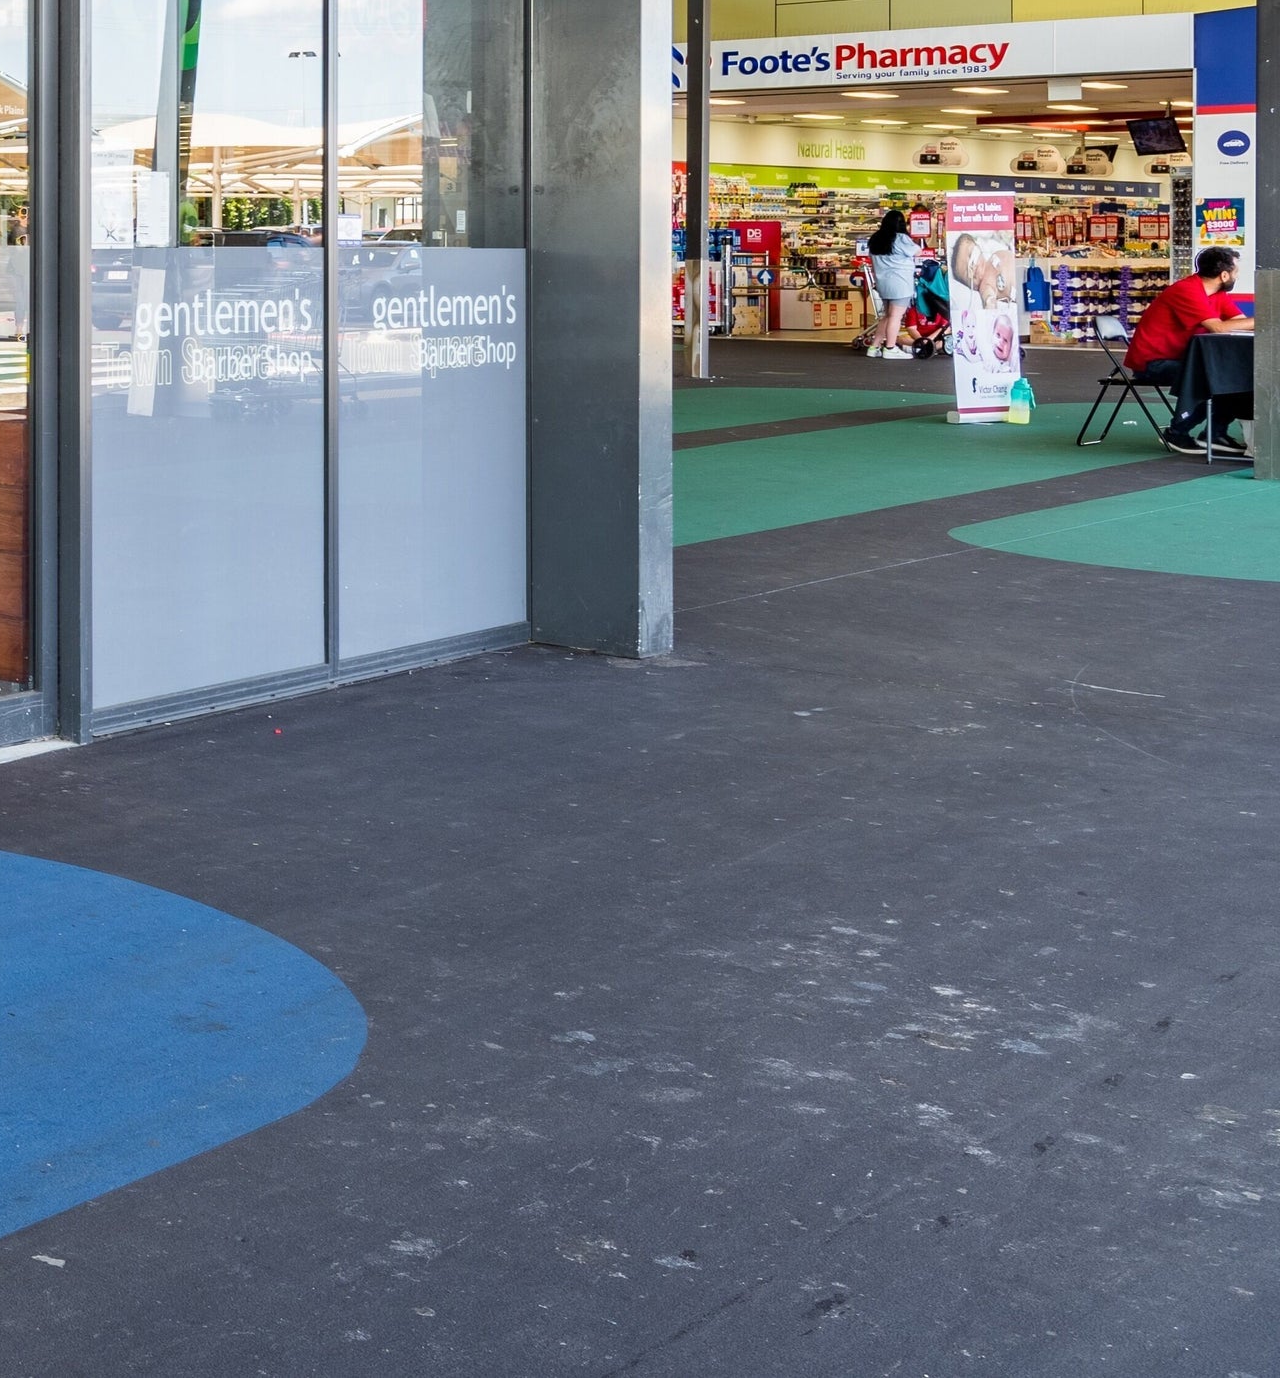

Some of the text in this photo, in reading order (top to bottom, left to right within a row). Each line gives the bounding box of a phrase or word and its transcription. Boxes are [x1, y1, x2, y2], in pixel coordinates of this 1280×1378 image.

[722, 42, 1010, 76] Foote's Pharmacy
[836, 72, 872, 80] Serving
[875, 71, 896, 79] your
[900, 69, 930, 78] family
[962, 65, 988, 73] 1983
[4, 105, 25, 116] Plains
[797, 139, 866, 161] Natural Health
[985, 203, 1002, 211] babies
[1203, 208, 1237, 221] WIN!
[1206, 220, 1235, 229] $3000
[746, 228, 762, 238] DB
[372, 285, 516, 333] gentlemen's
[135, 288, 312, 350] gentlemen's
